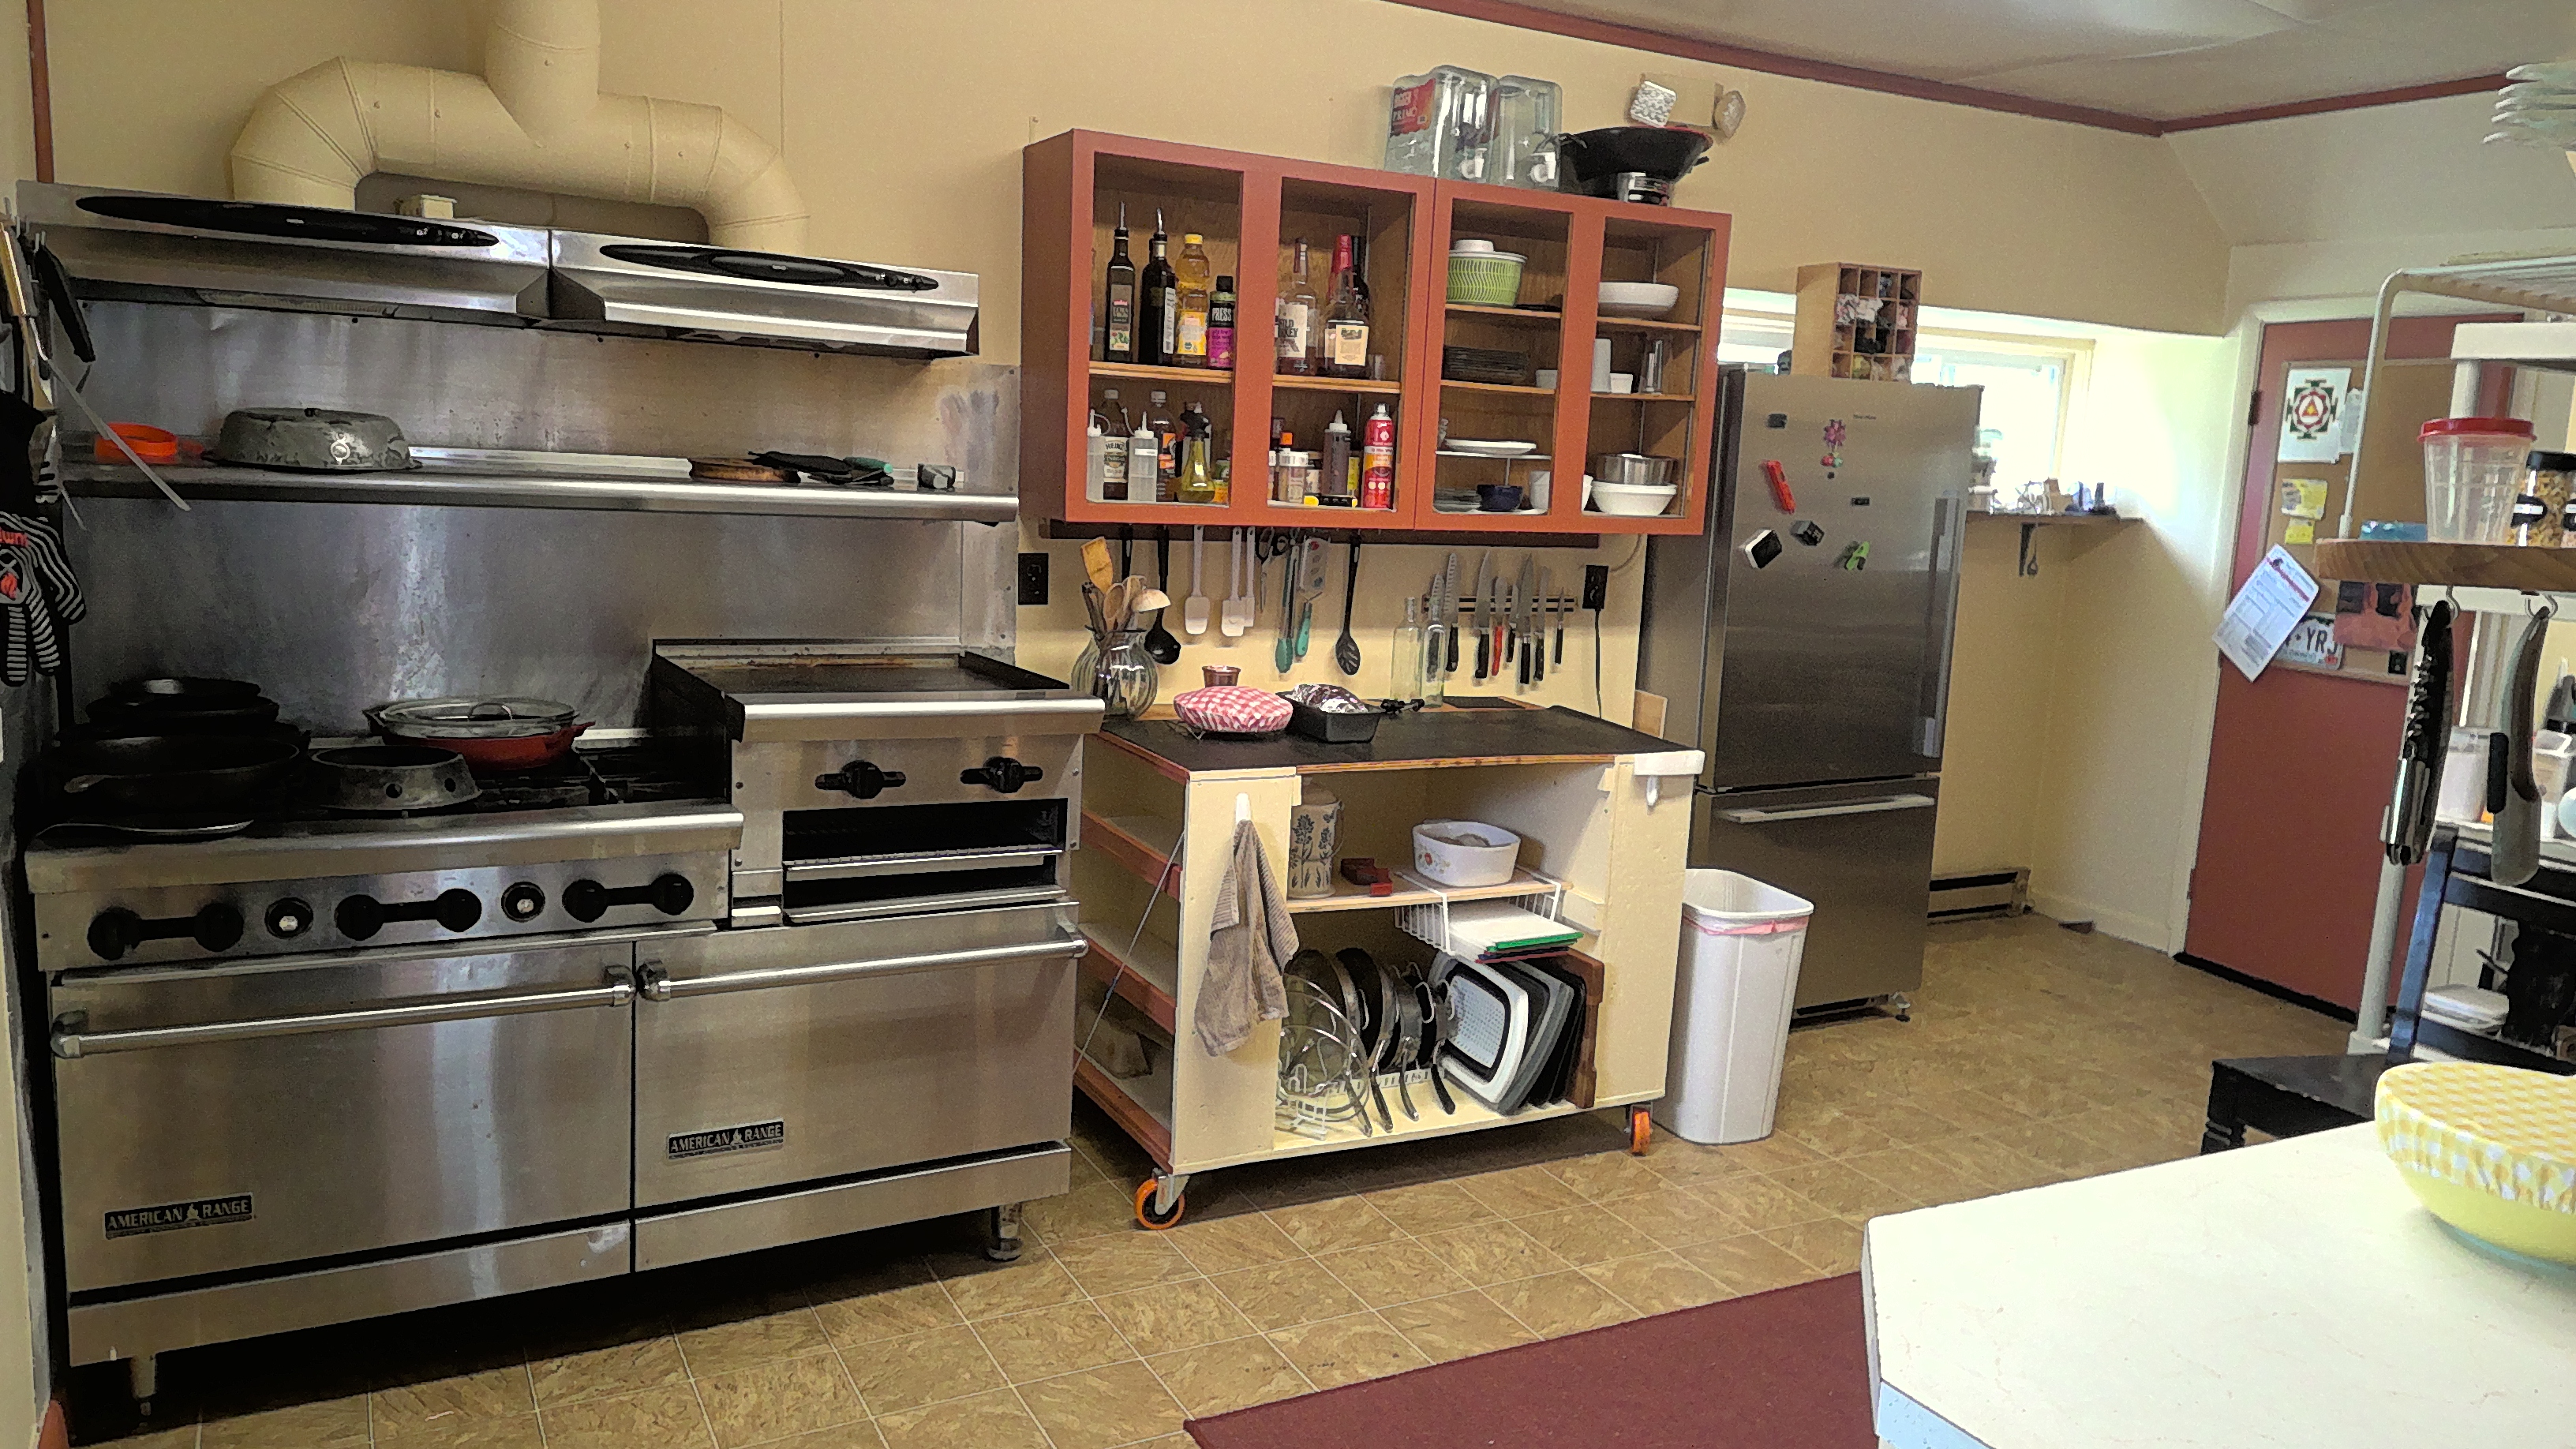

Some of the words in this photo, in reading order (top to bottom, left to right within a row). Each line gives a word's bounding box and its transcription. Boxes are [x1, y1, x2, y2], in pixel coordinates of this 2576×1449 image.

[1211, 307, 1232, 321] PRESS
[671, 1131, 730, 1152] AMERICAN
[744, 1125, 782, 1141] RANGE
[107, 1206, 183, 1230] AMERICAN
[202, 1199, 249, 1218] RANGE
